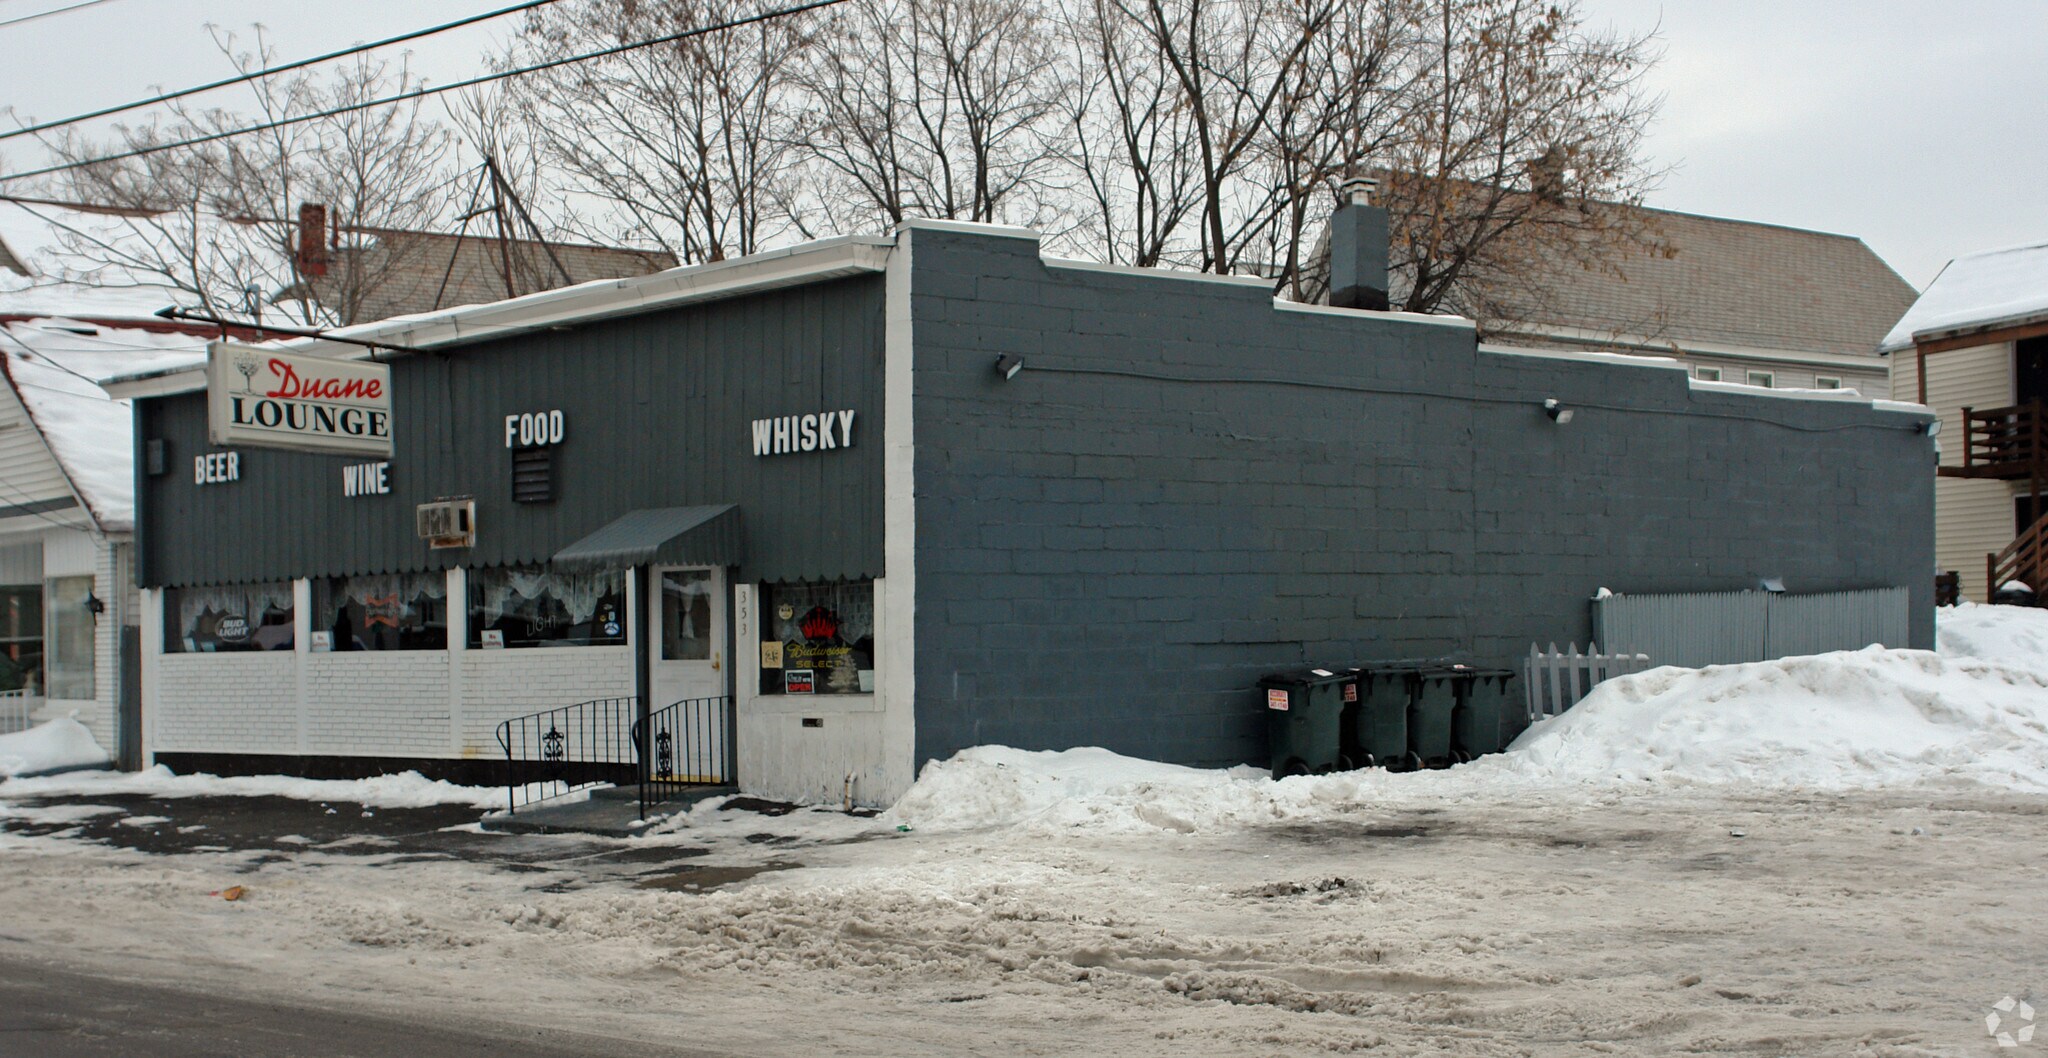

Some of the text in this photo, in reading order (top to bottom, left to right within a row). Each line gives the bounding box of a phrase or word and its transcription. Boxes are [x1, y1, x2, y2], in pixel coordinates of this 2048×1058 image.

[266, 358, 383, 399] Duane
[231, 397, 388, 437] LOUNGE
[505, 409, 565, 448] FOOD
[752, 409, 856, 456] WHISKY
[194, 451, 240, 486] BEER
[342, 461, 391, 498] WINE
[220, 627, 248, 636] LIGHT
[222, 619, 245, 627] BUD
[526, 614, 557, 637] LIGHT
[787, 643, 851, 658] Budweiser
[796, 660, 842, 668] SELECT
